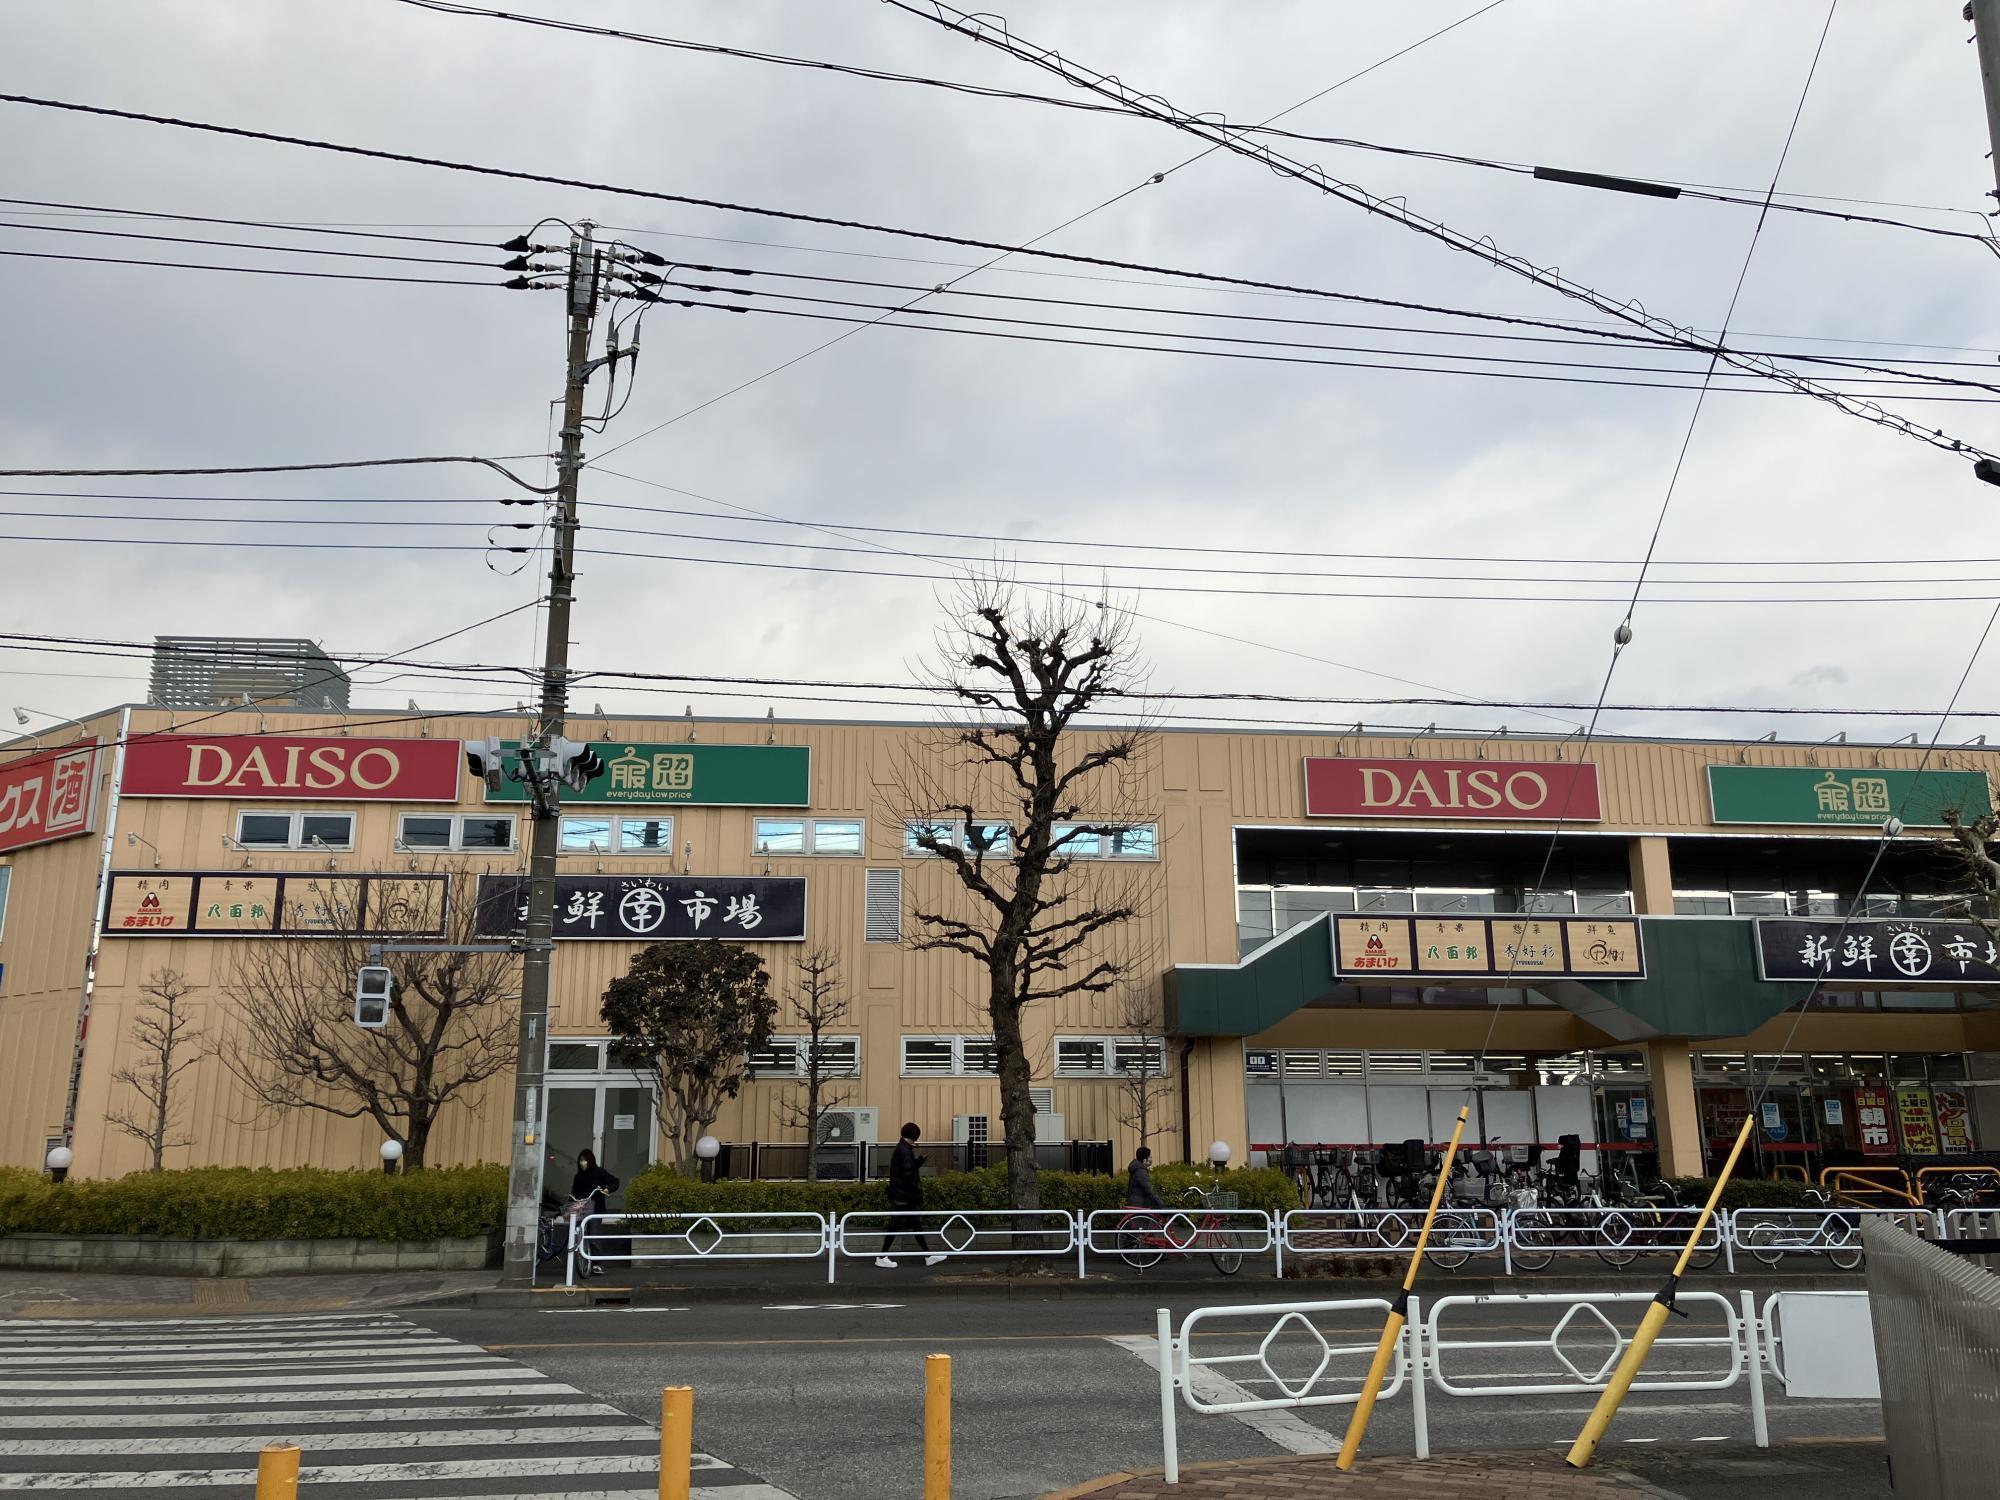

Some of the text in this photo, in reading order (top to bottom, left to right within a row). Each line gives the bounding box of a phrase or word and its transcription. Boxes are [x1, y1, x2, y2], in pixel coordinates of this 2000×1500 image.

[182, 743, 401, 791] DAISO
[52, 760, 86, 821] 酒
[1358, 768, 1549, 810] DAISO
[137, 879, 170, 891] 精肉
[223, 880, 255, 891] 青果
[620, 877, 670, 892] さいわい
[207, 903, 265, 919] 八百邦
[122, 915, 174, 928] あまいけ
[1359, 921, 1389, 933] 精肉
[1435, 922, 1464, 934] 青果
[1513, 924, 1542, 935] 惣菜
[1586, 924, 1617, 936] 鮮魚
[1886, 922, 1931, 936] さいわい
[1427, 945, 1478, 960] 八百邦
[1504, 943, 1555, 959] 秀好彩
[1353, 957, 1398, 968] あまいけ
[1860, 1107, 1888, 1145] 朝市
